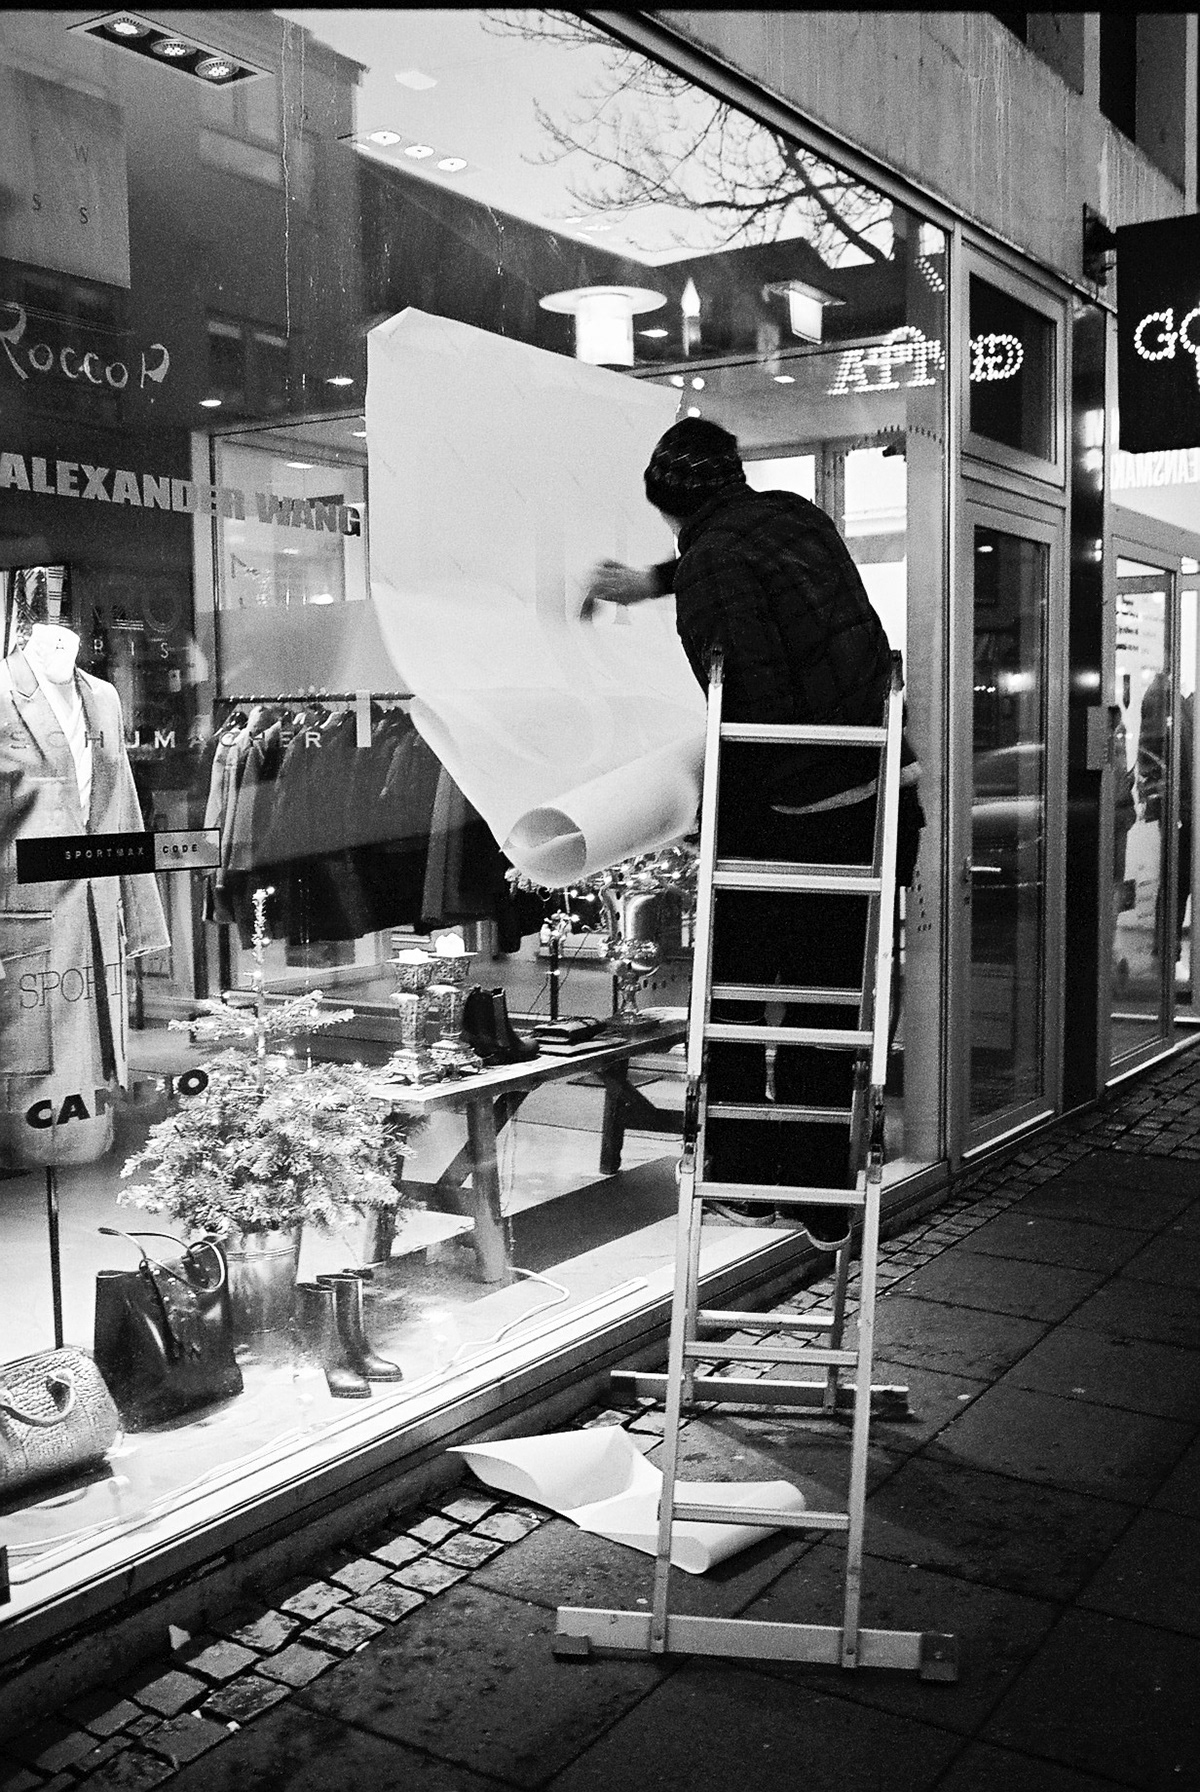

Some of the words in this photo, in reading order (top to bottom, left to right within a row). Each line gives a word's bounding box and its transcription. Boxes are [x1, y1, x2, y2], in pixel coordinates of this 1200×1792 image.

[0, 452, 246, 521] ALEXANDER
[255, 492, 361, 537] WANG
[65, 846, 144, 860] SPORTMAX
[162, 843, 198, 854] CODE
